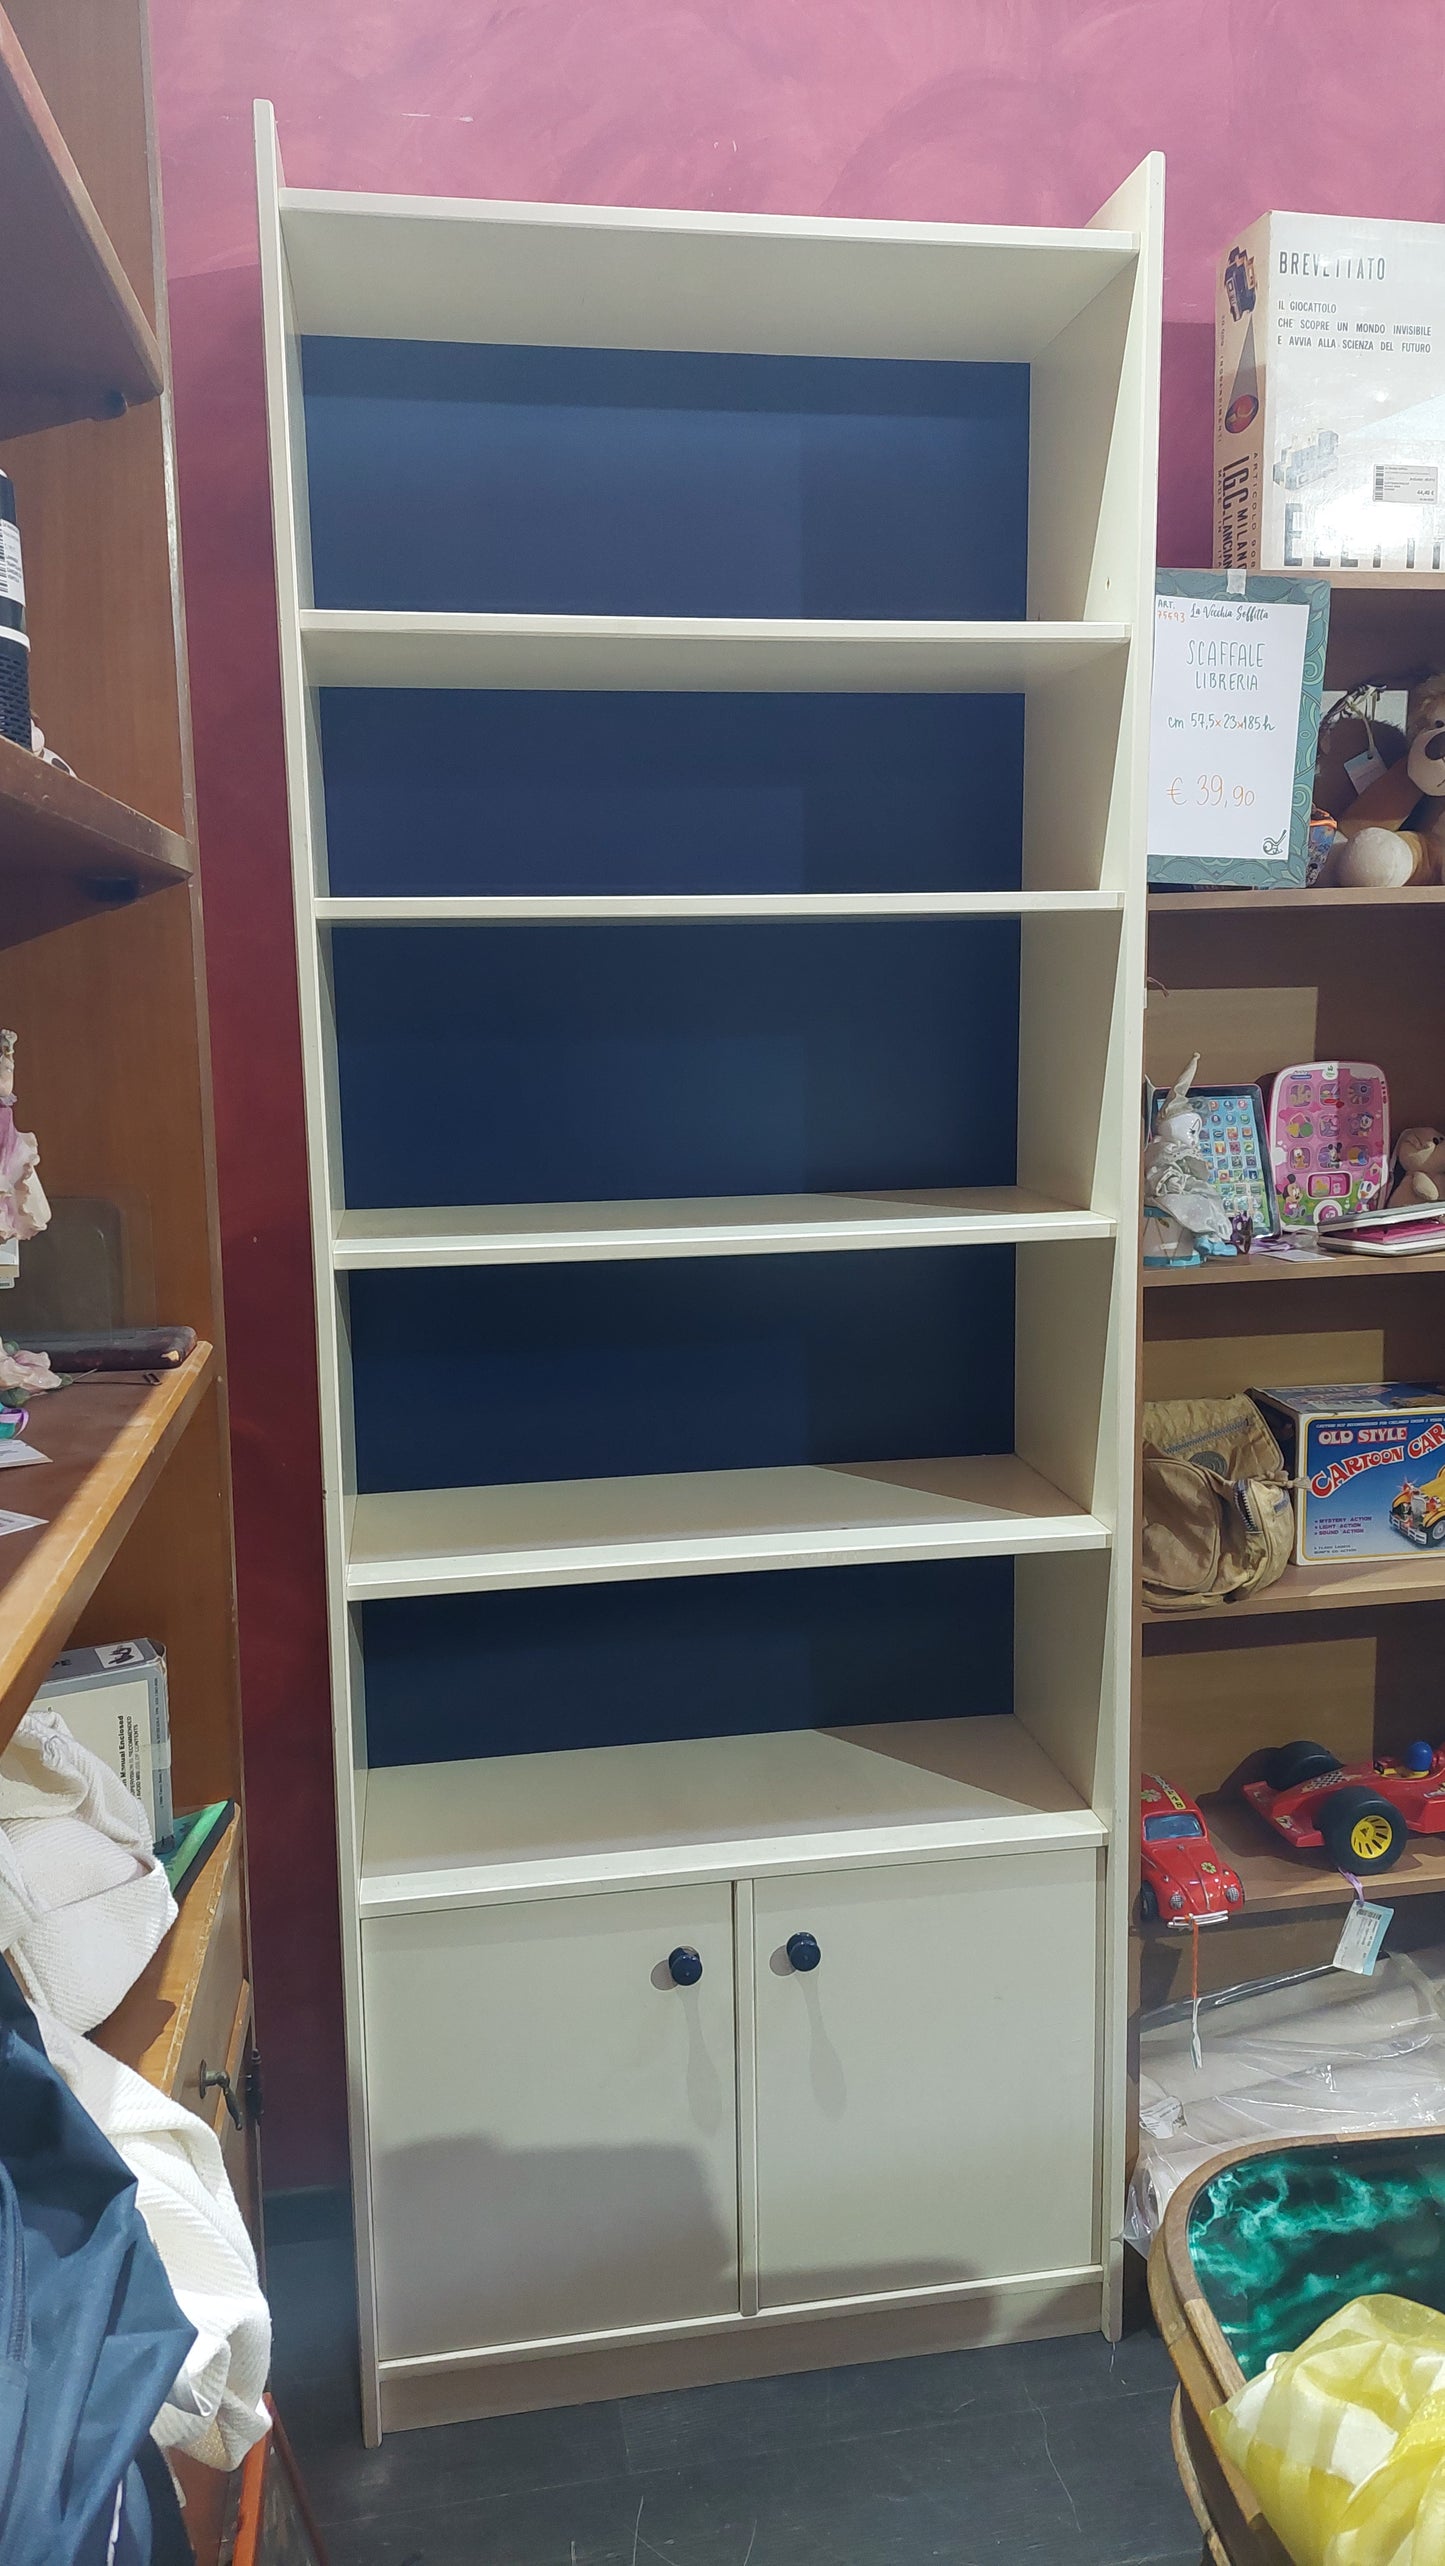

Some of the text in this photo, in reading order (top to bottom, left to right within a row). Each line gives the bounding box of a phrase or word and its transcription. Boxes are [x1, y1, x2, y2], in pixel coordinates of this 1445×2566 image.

[1278, 301, 1337, 313] IL GIOCATTOLO
[1278, 318, 1432, 336] CHE SCOPRE UN MONDO INVISIBILE
[1277, 335, 1431, 353] E AVVIA ALLA SCIENZA DEL FUTURO
[1157, 599, 1175, 609] ART.
[1190, 603, 1269, 622] La Vecchia Soffitta
[1186, 640, 1266, 667] SCAFFALE
[1195, 671, 1258, 691] LIBRERIA
[1168, 716, 1184, 729] cm
[1166, 774, 1255, 808] € 39,90
[1318, 1427, 1408, 1445] OLD STYLE
[1311, 1445, 1405, 1498] CARTOON
[117, 1715, 125, 1750] Enclosed
